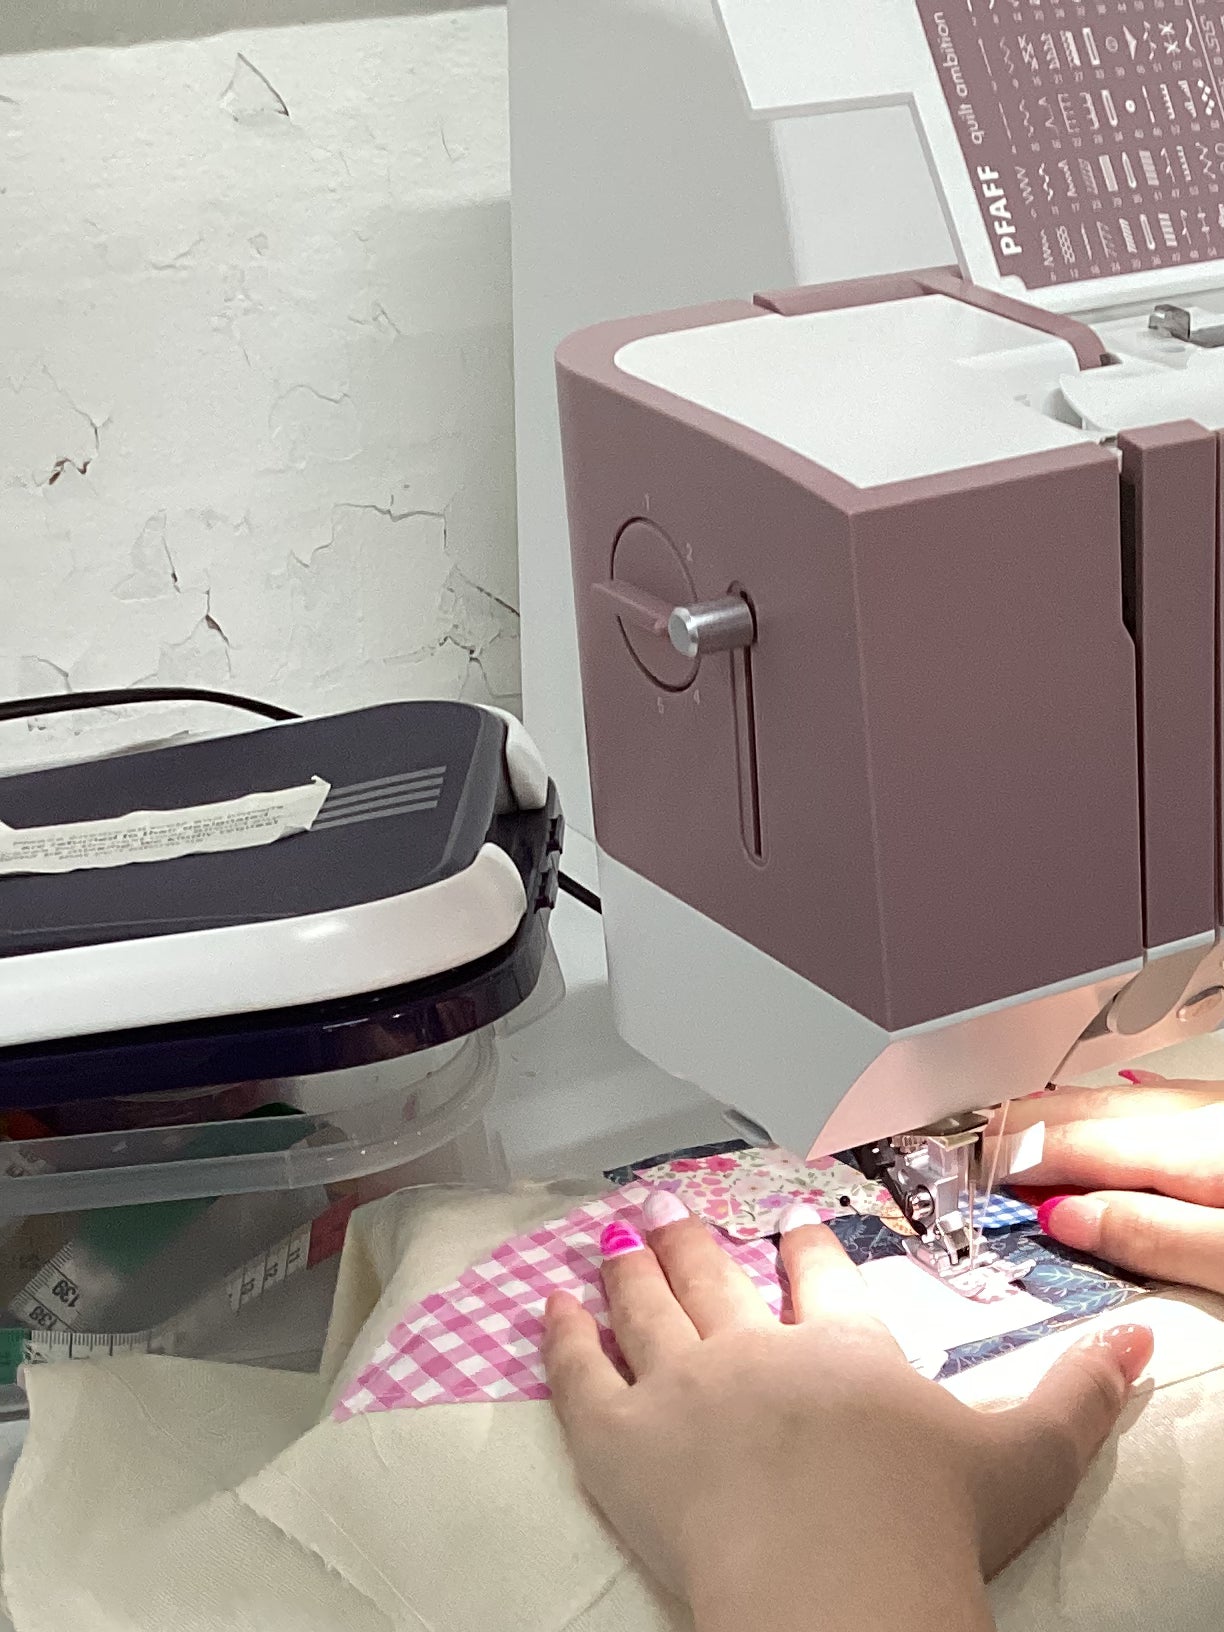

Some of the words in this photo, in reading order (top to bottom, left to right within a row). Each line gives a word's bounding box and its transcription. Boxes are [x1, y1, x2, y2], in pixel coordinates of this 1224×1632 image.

[933, 11, 969, 97] ambition
[957, 103, 985, 145] quilt
[976, 164, 1023, 257] PFAFF
